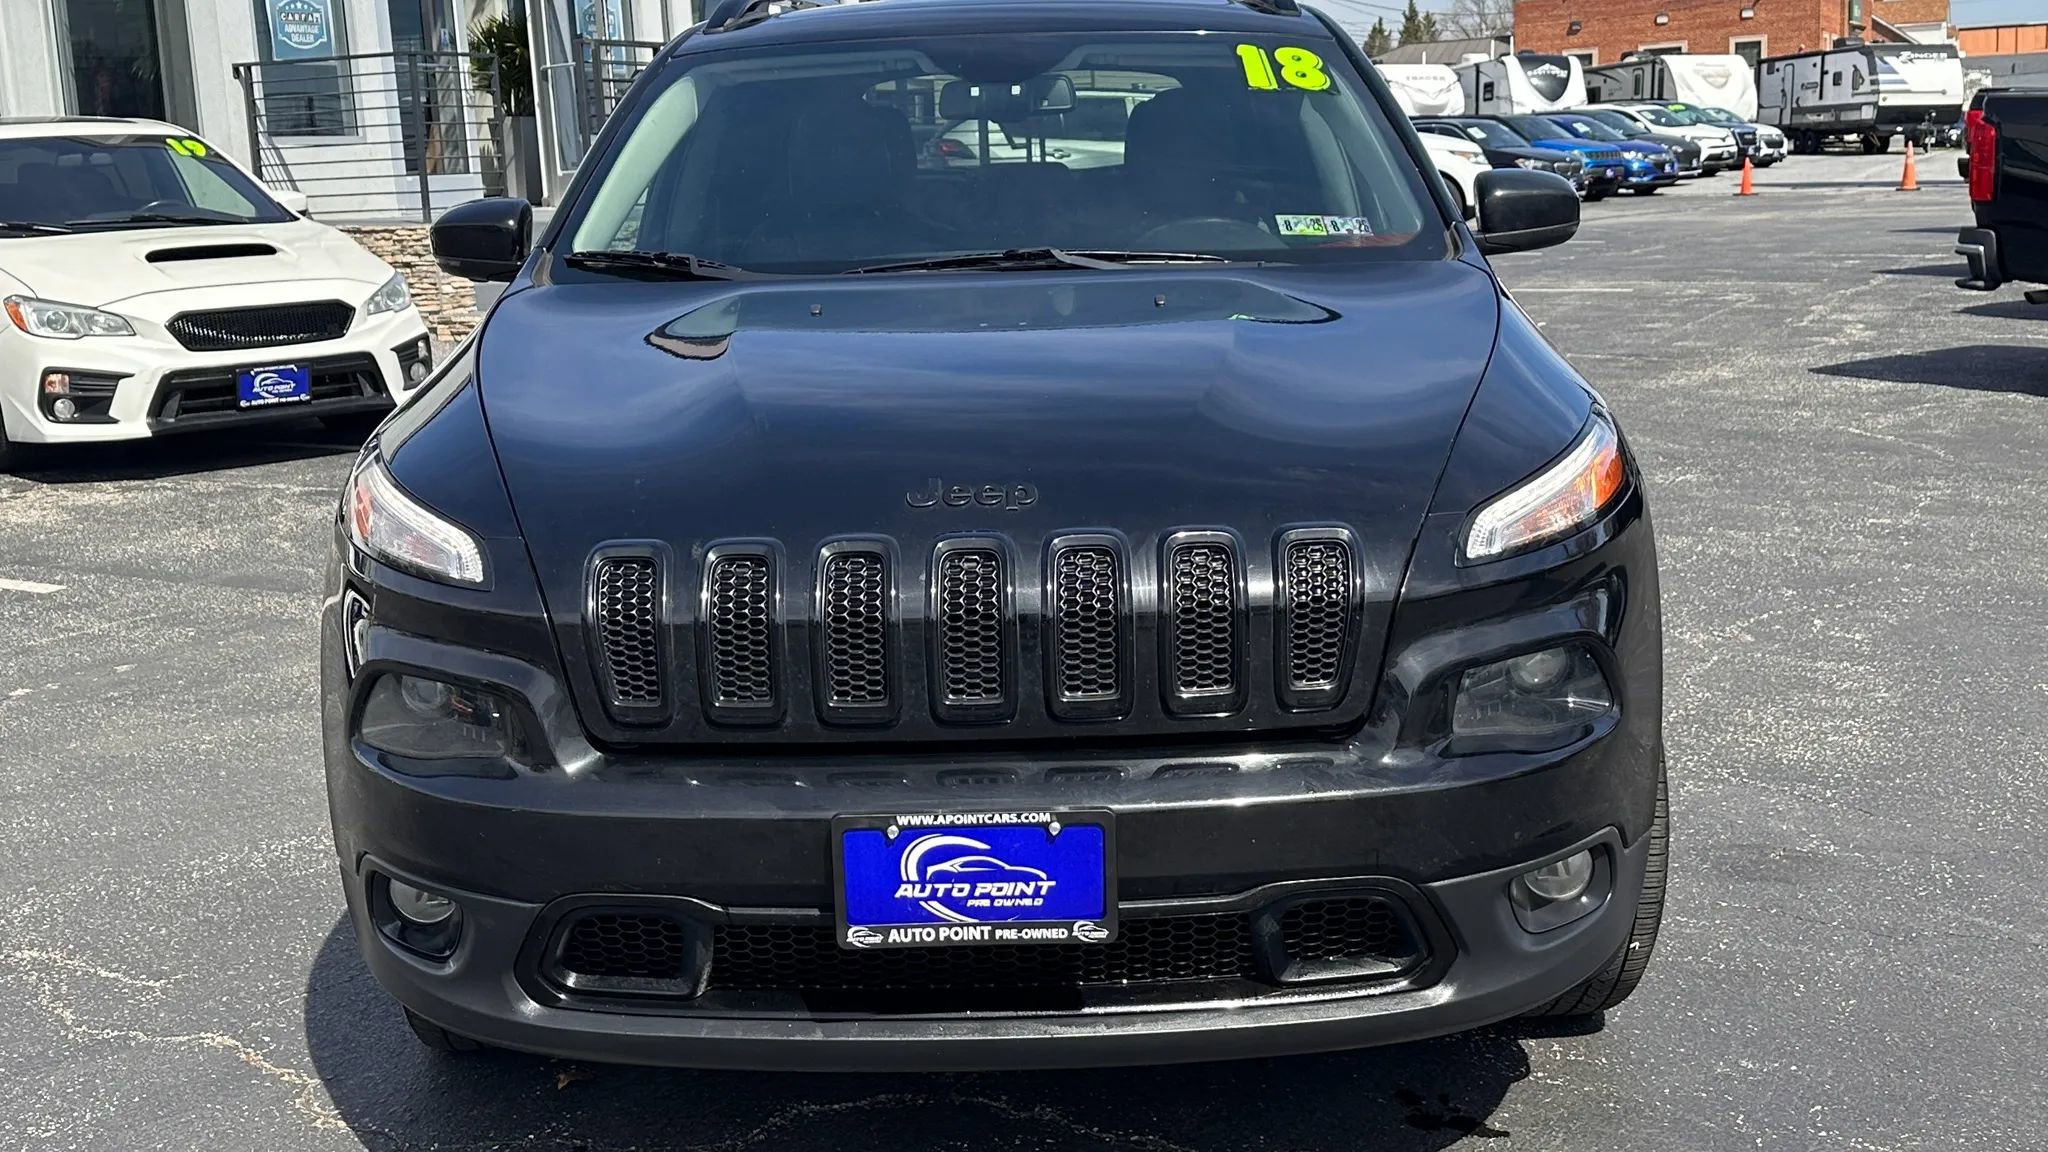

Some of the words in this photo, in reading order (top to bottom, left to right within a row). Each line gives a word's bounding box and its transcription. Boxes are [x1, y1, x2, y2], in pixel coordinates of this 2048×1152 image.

[284, 24, 321, 33] ADVANTAGE
[291, 33, 315, 42] DEALER
[1236, 44, 1331, 91] 18
[165, 138, 207, 157] 19
[1283, 219, 1293, 232] 8
[1330, 219, 1341, 232] 8
[905, 478, 1039, 511] Jeep
[896, 813, 1051, 826] WWW.APOINTCARS.COM
[894, 883, 971, 898] AUTO
[973, 881, 1057, 897] POINT
[966, 899, 991, 907] PRE
[993, 898, 1044, 907] OWNED
[887, 927, 936, 943] AUTO
[939, 926, 992, 942] POINT
[994, 928, 1069, 940] PRE-OWNED
